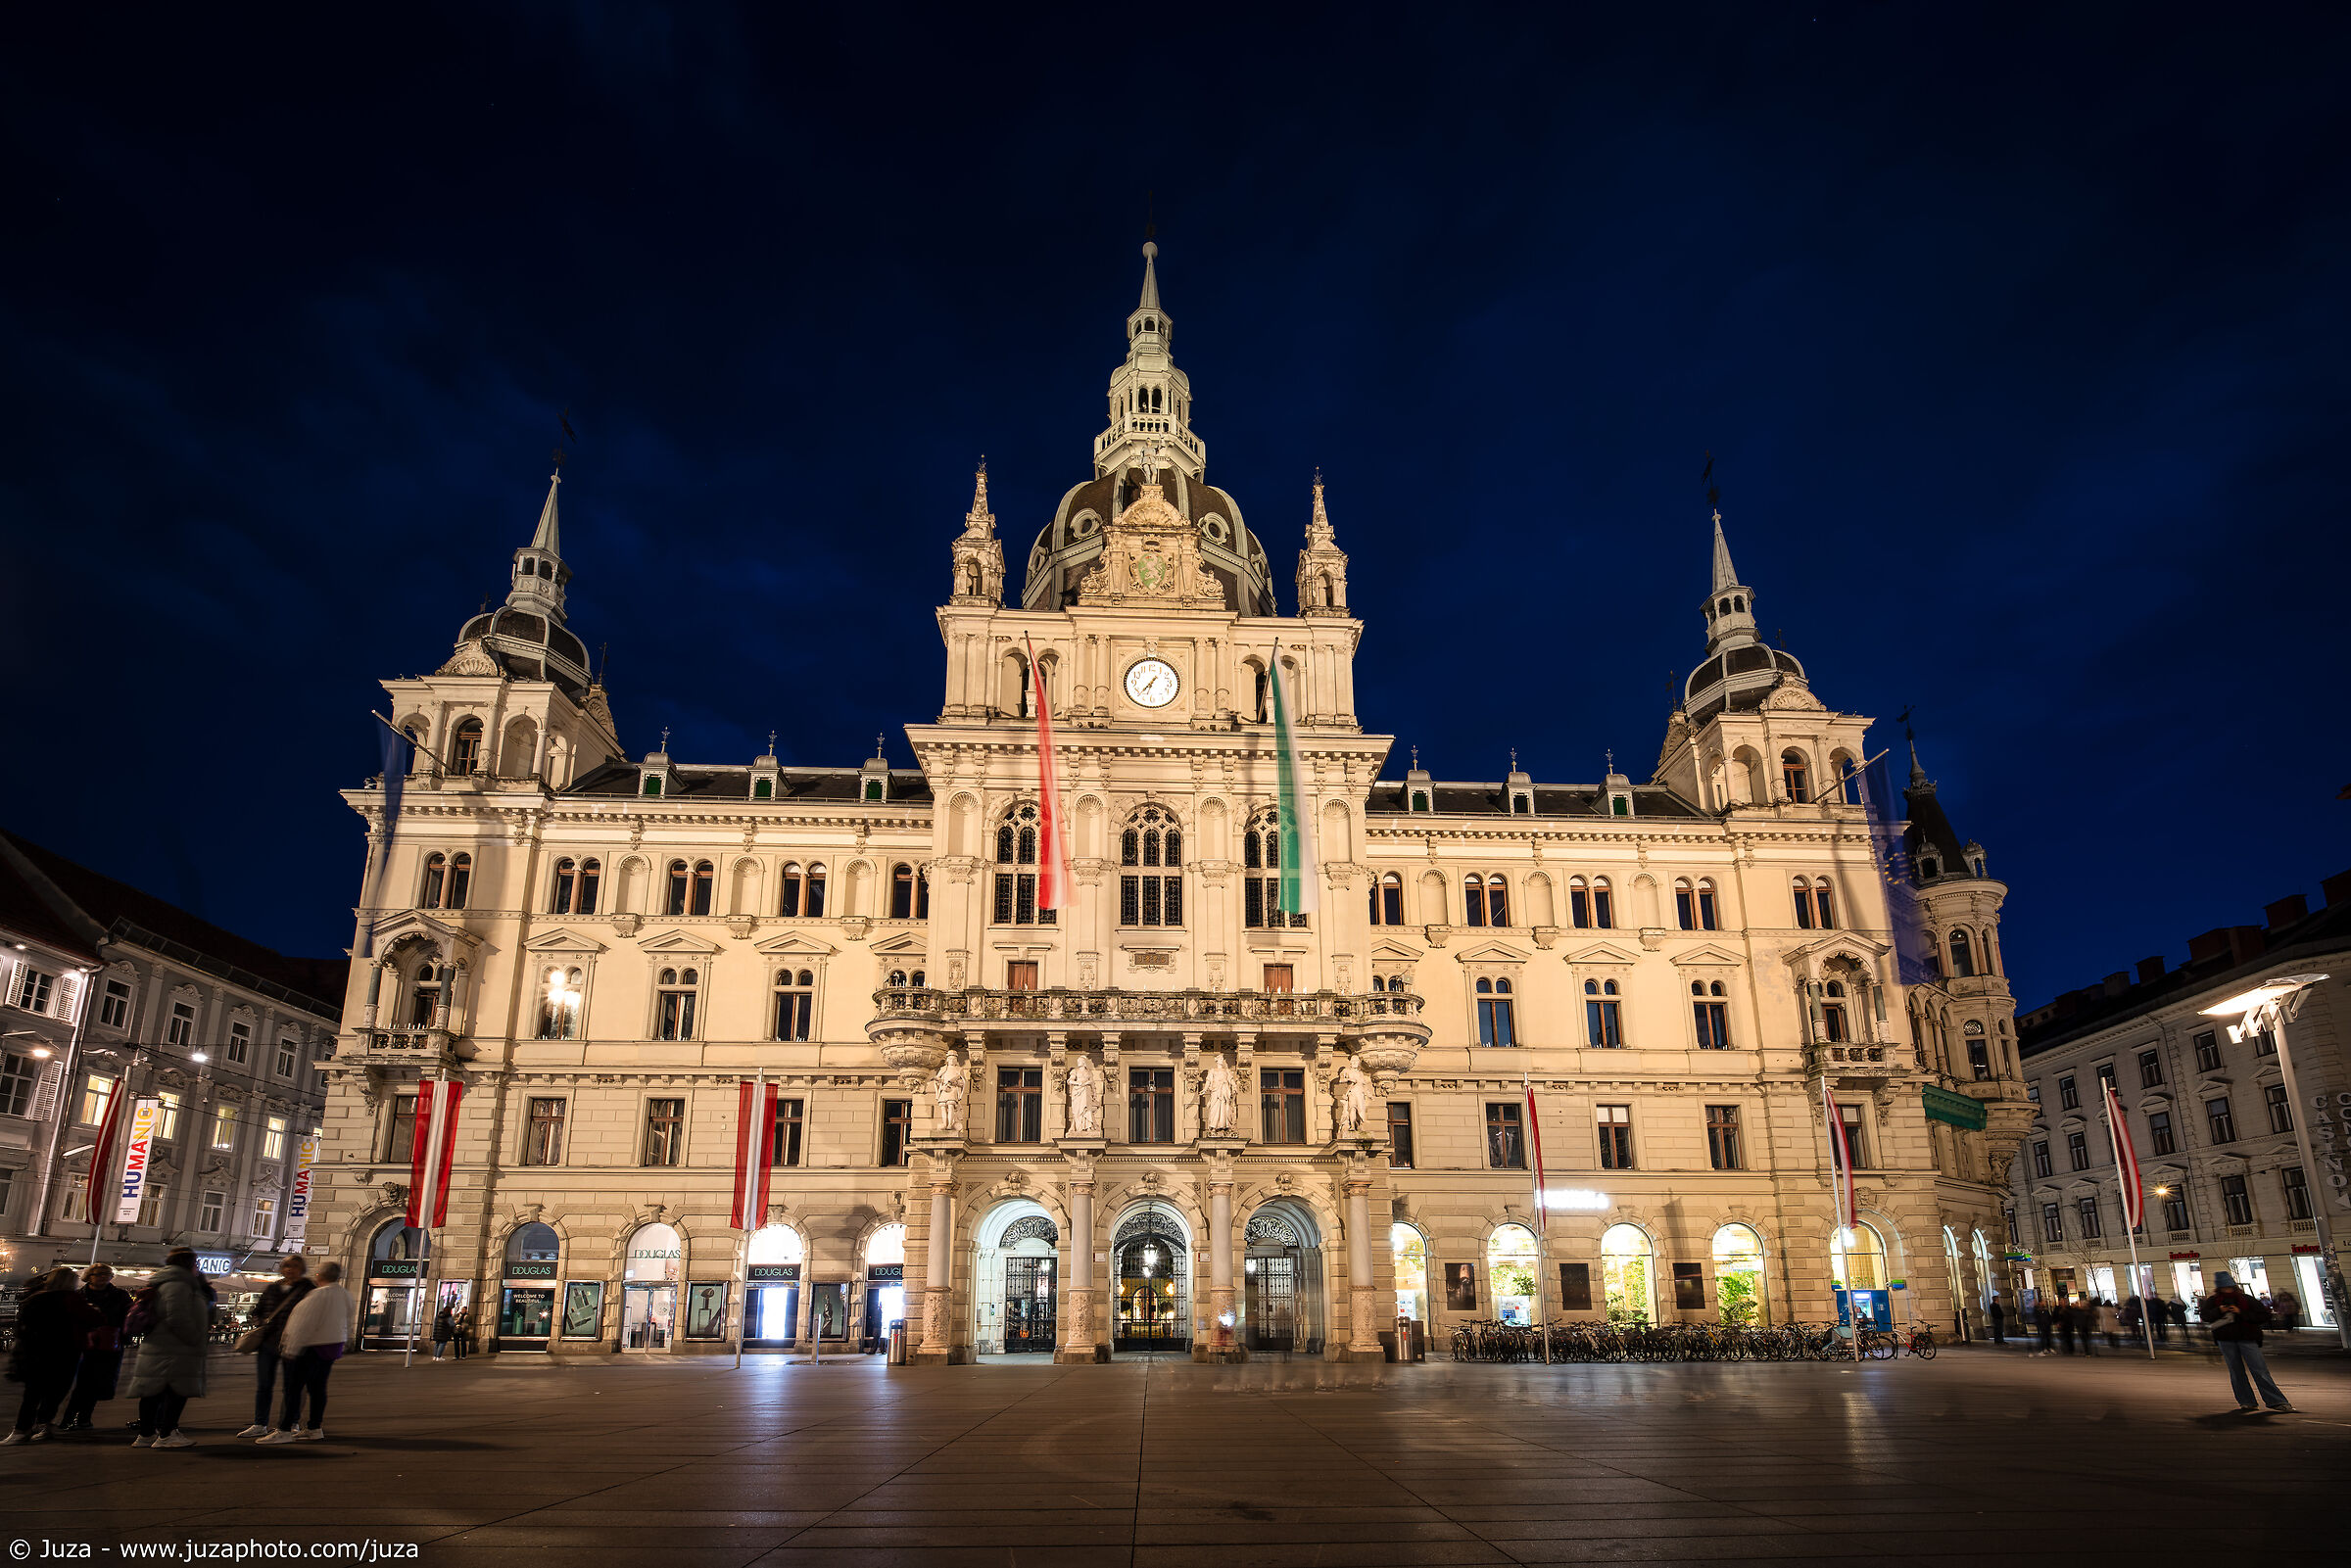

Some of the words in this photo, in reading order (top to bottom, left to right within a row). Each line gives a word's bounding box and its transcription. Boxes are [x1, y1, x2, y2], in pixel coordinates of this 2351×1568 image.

[121, 1108, 154, 1198] HUMANIC
[2310, 1095, 2348, 1188] CASINO
[291, 1142, 314, 1217] HUMANIC
[511, 1266, 552, 1275] DOUGLAS
[634, 1249, 681, 1259] DOUGLAS
[754, 1267, 793, 1276] DOUGLAS
